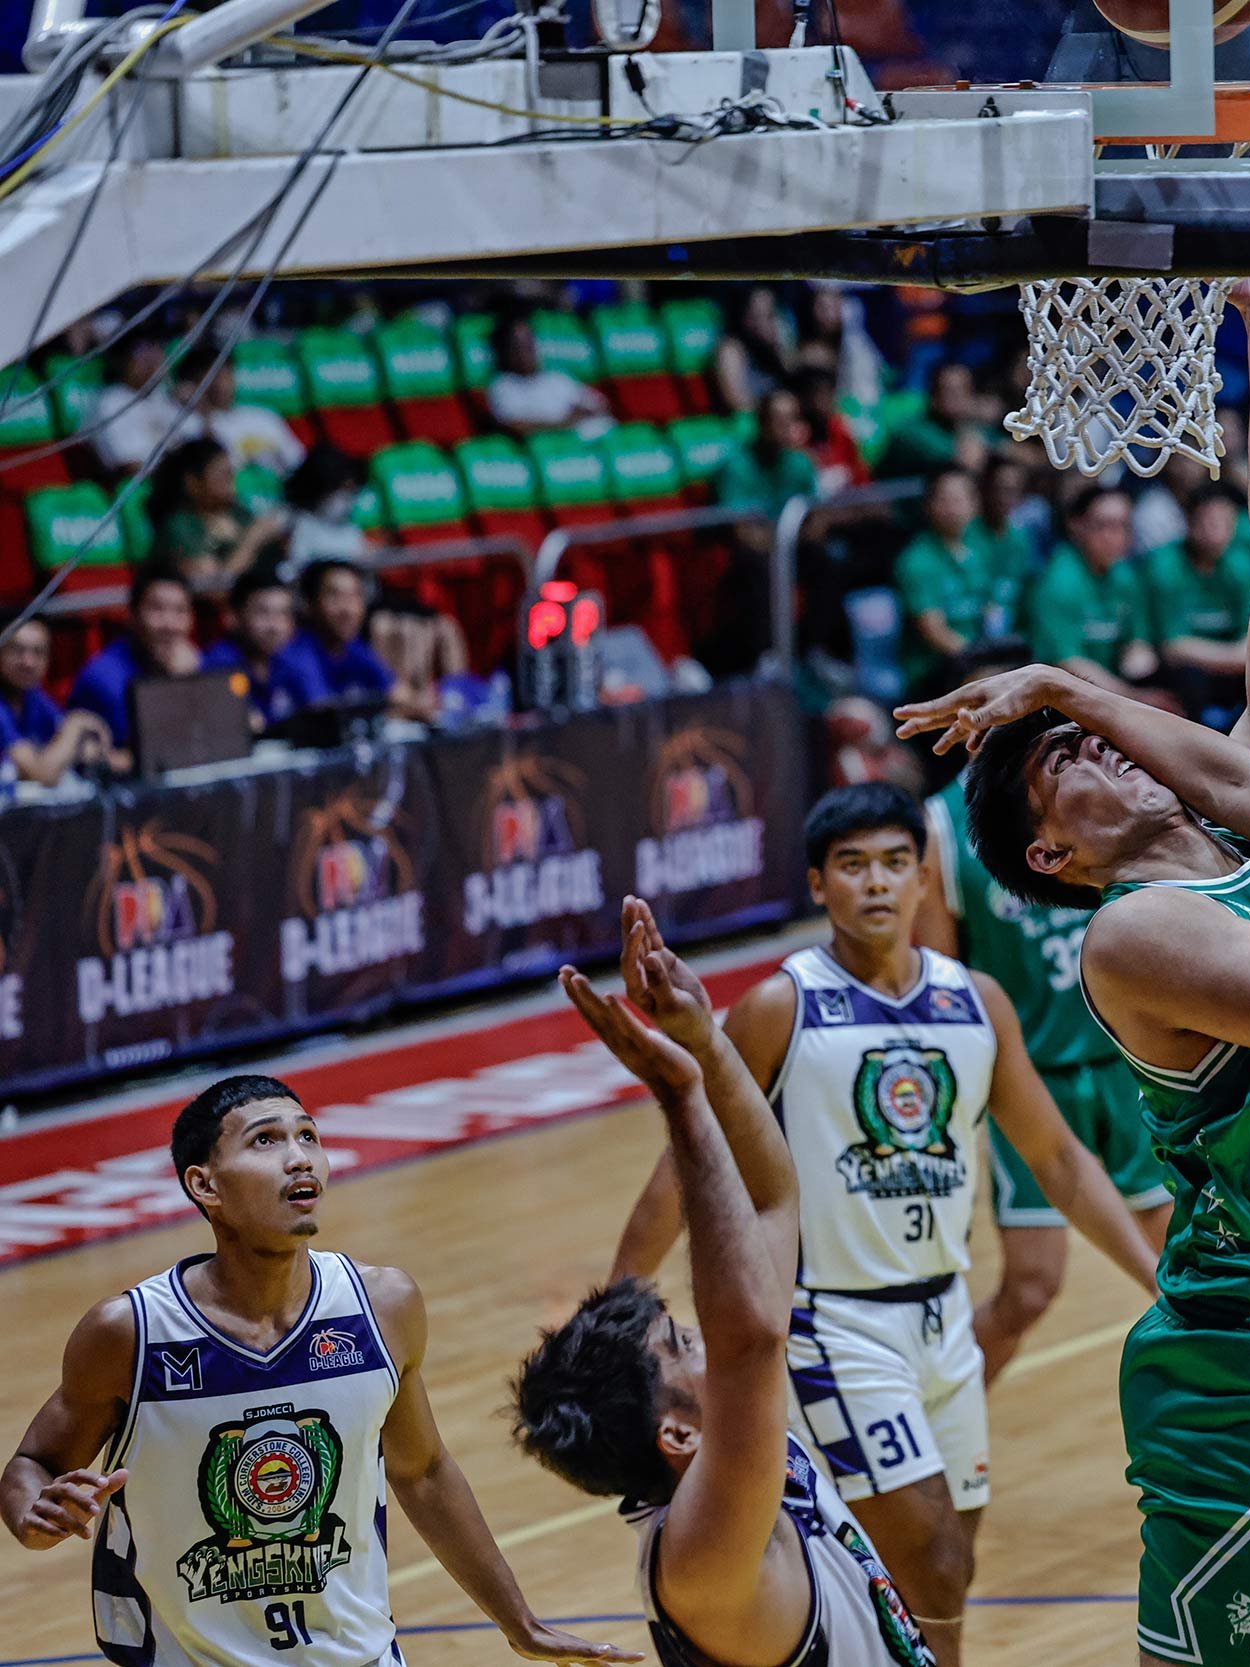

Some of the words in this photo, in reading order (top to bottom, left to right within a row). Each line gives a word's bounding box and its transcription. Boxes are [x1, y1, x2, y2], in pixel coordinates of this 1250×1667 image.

[904, 1202, 934, 1243] 31
[309, 1351, 365, 1372] D-LEAGUE
[245, 1404, 293, 1420] SJDMCCI
[865, 1411, 921, 1469] 31
[239, 1441, 288, 1487] CORNERSTONE
[289, 1445, 311, 1486] COLLEGE
[241, 1487, 263, 1511] SJDM
[266, 1504, 287, 1514] 2004
[264, 1600, 313, 1651] 91
